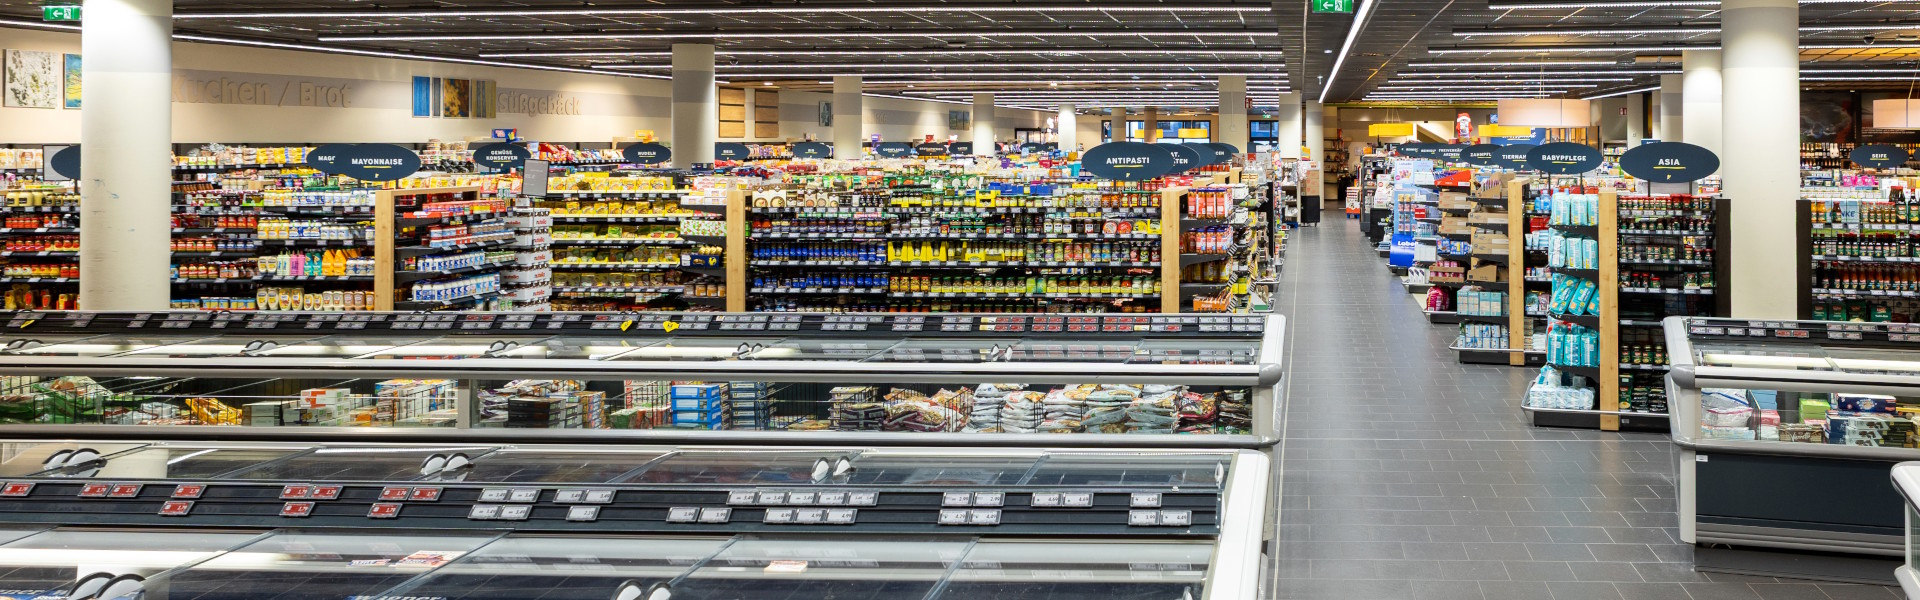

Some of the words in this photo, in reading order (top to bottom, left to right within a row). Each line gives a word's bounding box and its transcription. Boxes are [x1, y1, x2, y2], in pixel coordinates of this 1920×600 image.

[299, 82, 352, 108] Brot
[498, 91, 583, 117] Süßgebäck
[1106, 156, 1150, 165] ANTIPASTI
[1541, 154, 1587, 162] BABYPFLEGE
[1658, 158, 1680, 166] ASIA
